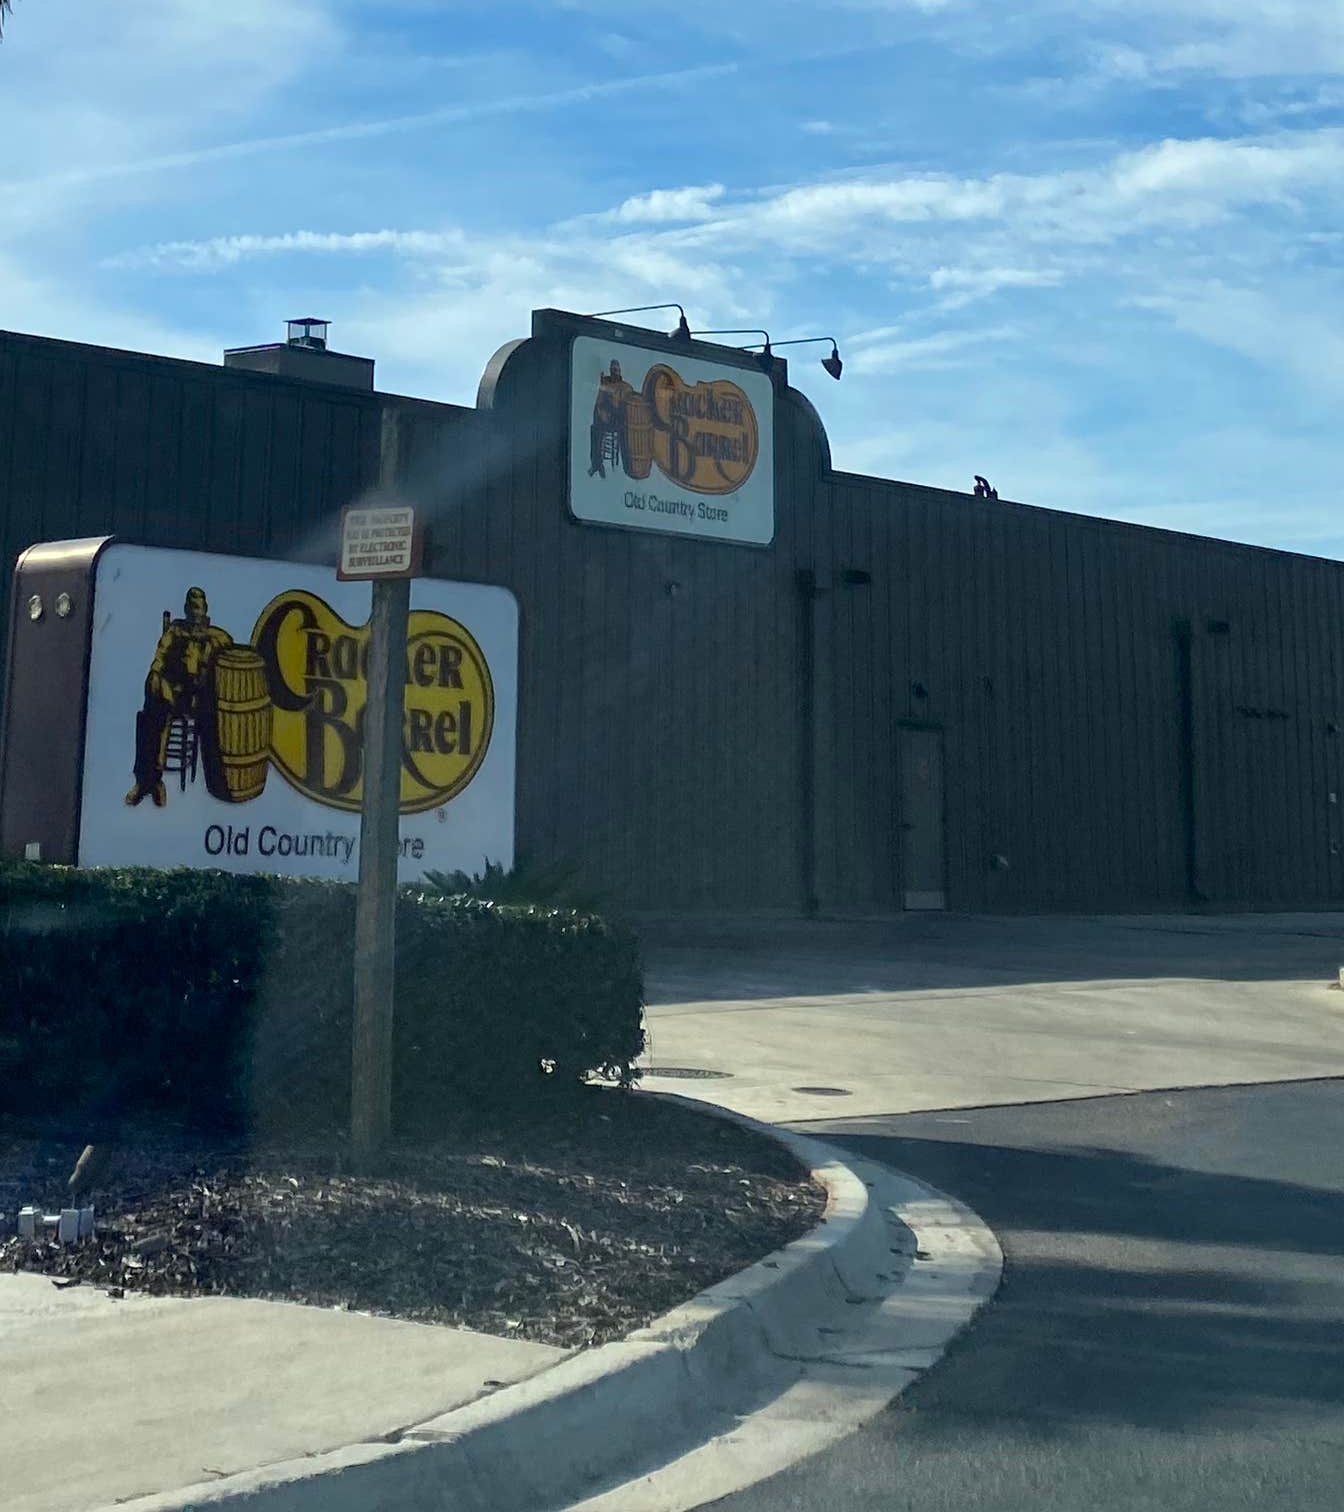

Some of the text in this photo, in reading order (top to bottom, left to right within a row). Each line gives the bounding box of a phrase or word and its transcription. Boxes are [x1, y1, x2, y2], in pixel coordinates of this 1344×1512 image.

[624, 491, 728, 522] Old Country Store
[348, 554, 404, 568] SURVEILLANCE
[359, 540, 408, 553] ELECTRONIC
[256, 600, 464, 711] Craer
[304, 679, 472, 796] Brel
[205, 824, 356, 864] Old Country
